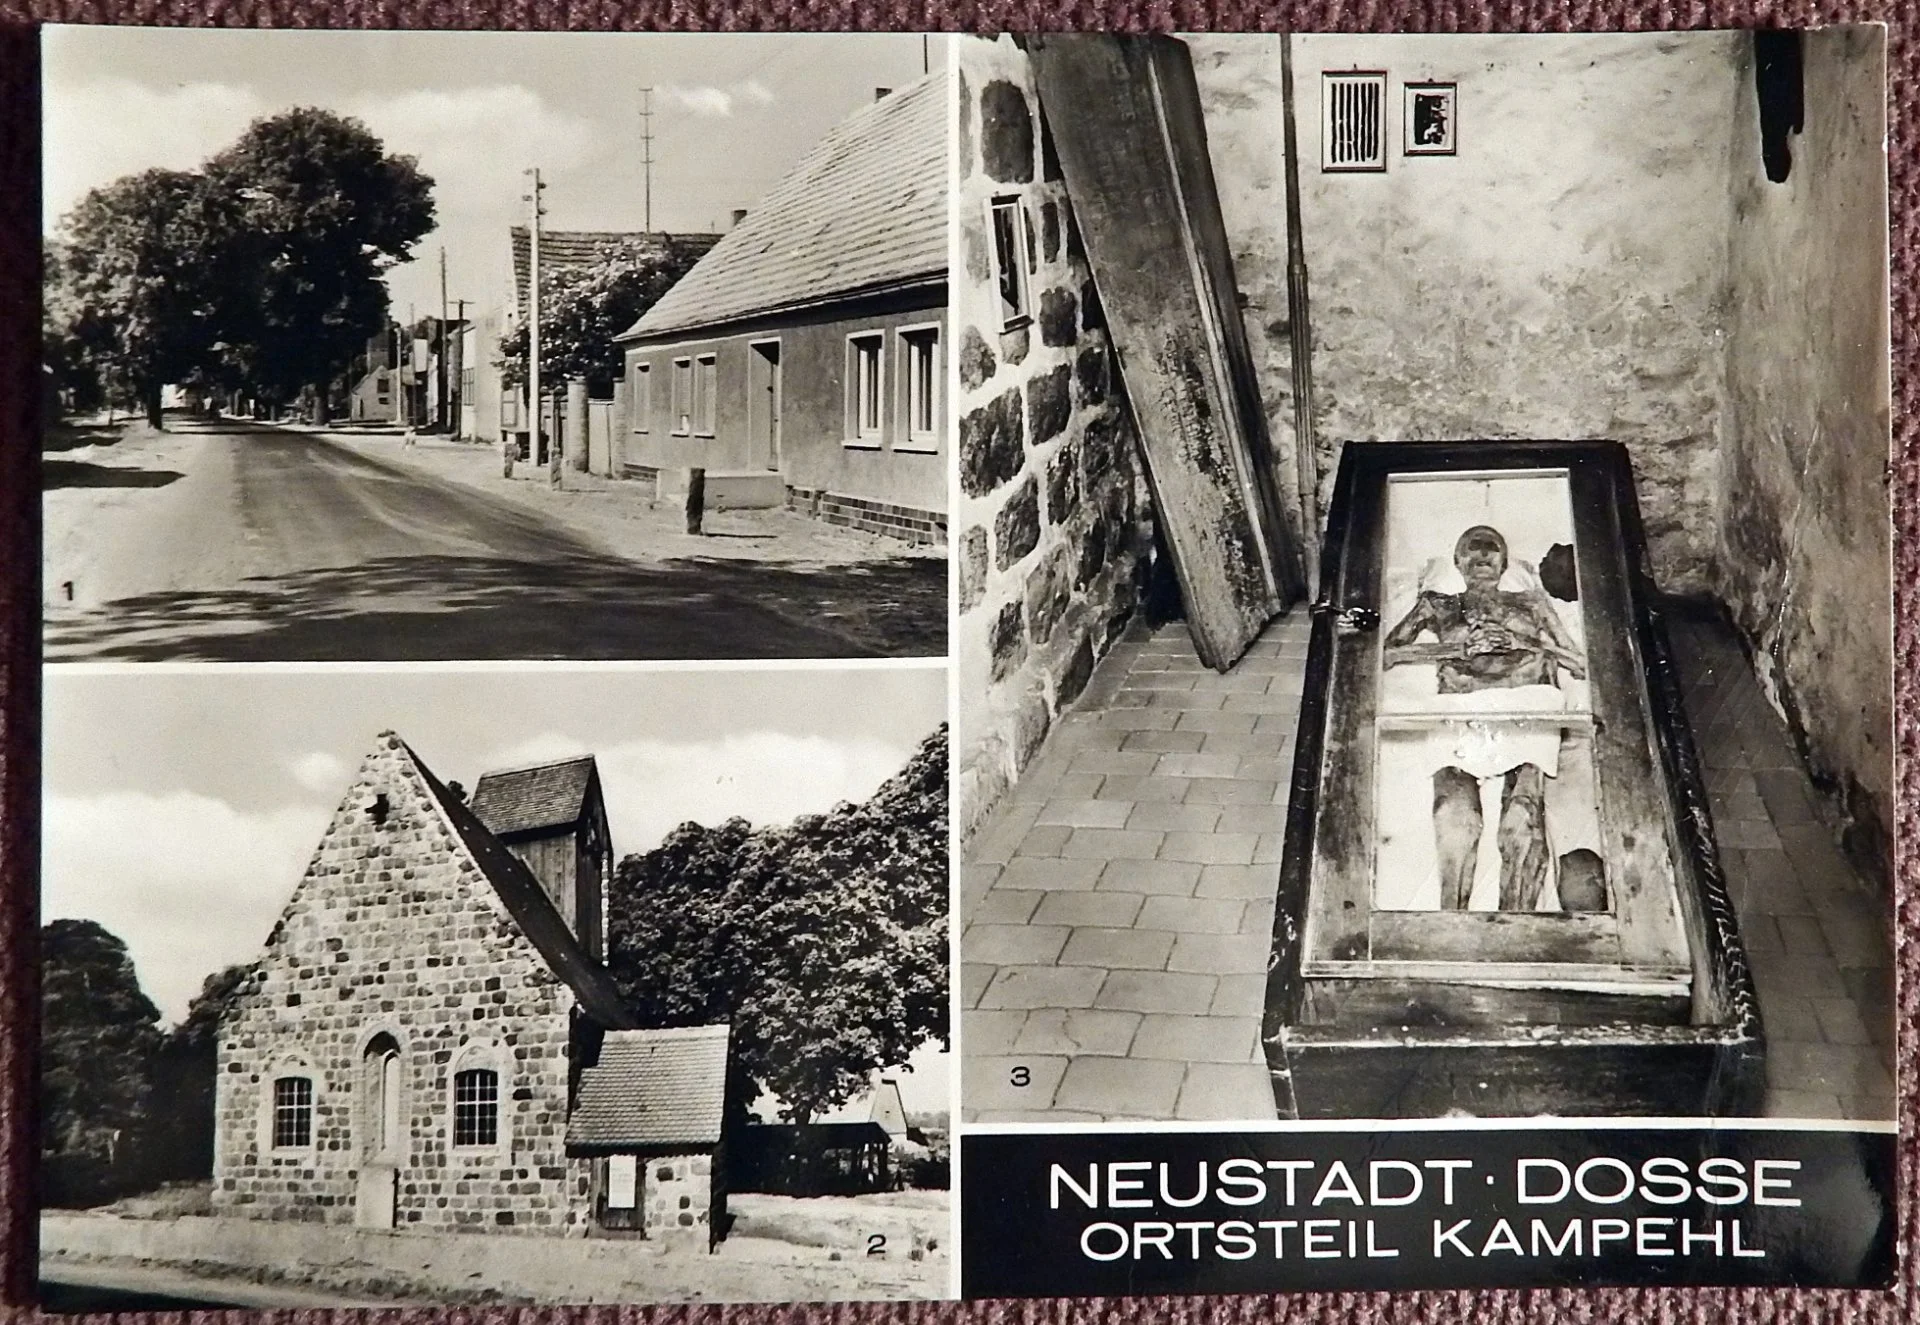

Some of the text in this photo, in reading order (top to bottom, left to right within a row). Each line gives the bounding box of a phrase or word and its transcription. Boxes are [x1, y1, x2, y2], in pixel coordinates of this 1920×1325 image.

[61, 580, 74, 601] 1
[1010, 1065, 1031, 1088] 3
[1050, 1157, 1802, 1210] NEUSTADT DOSSE
[866, 1233, 887, 1258] 2
[1080, 1217, 1766, 1262] ORTSTEIL KAMPEHL
